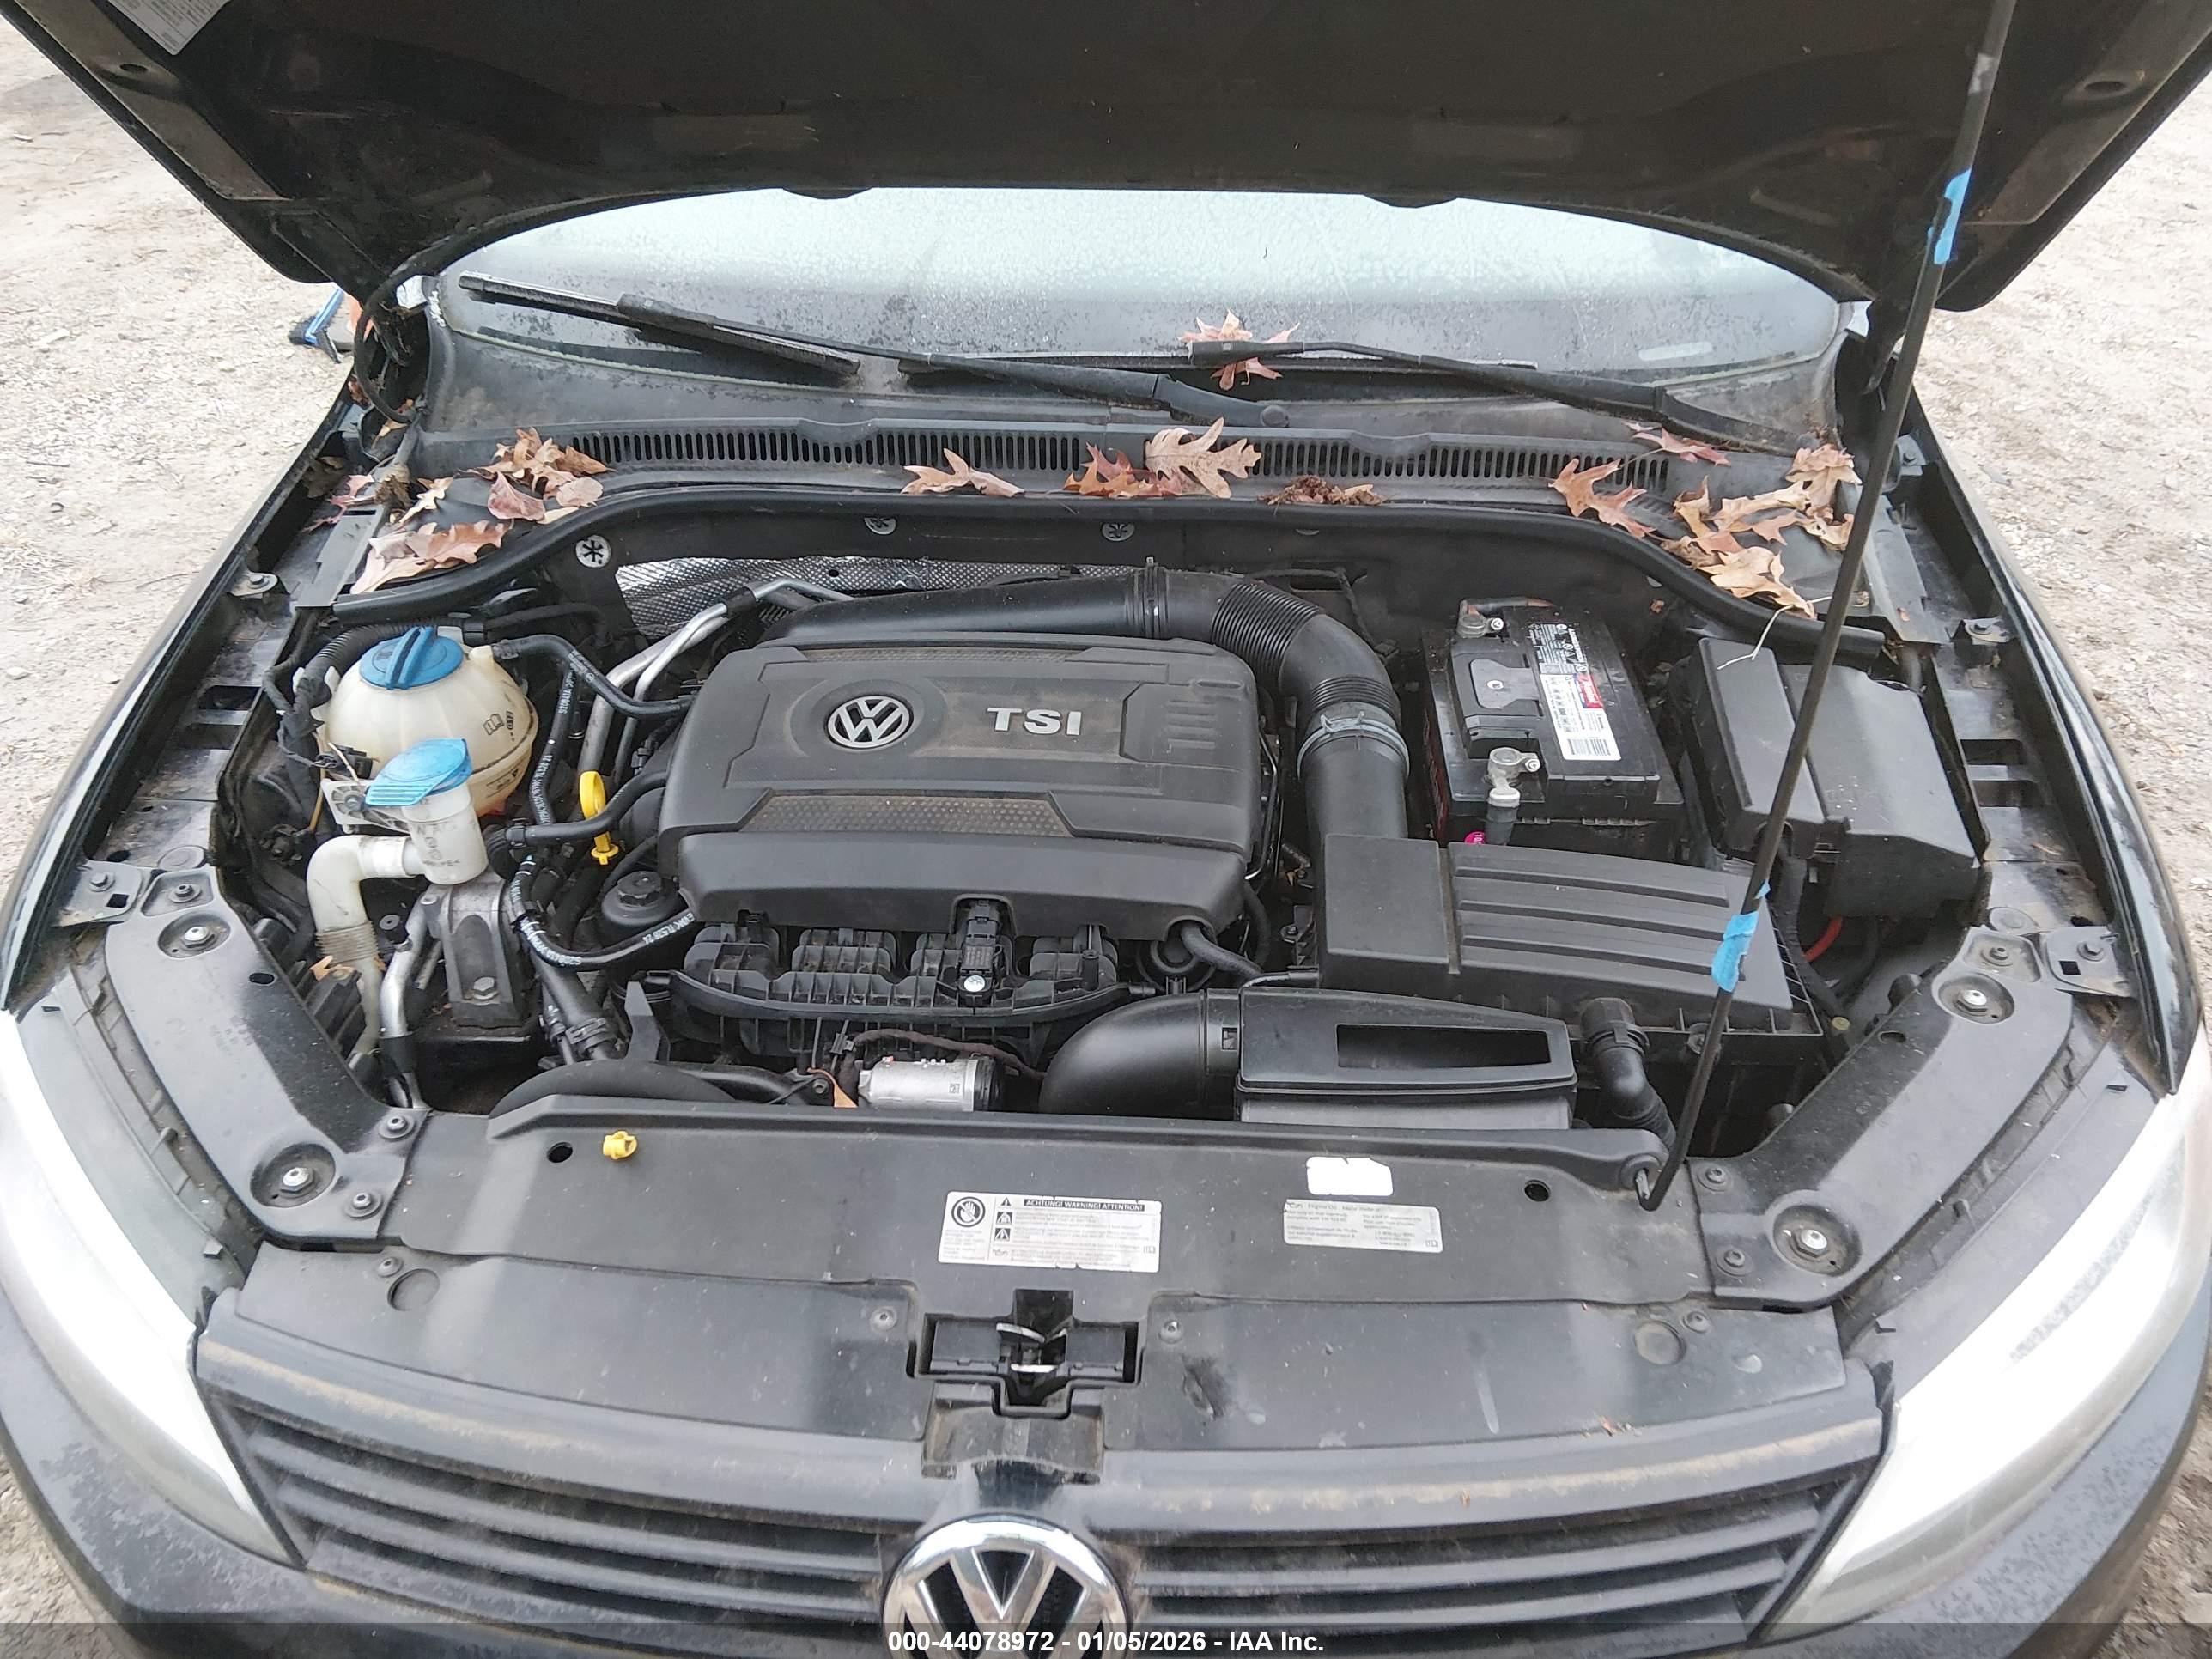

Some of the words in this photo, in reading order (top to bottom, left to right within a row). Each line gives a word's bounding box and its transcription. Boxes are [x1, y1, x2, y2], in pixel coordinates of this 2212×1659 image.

[987, 707, 1082, 736] TSI
[1025, 1199, 1063, 1207] ACHTUNG!
[1065, 1200, 1100, 1210] WARNING!
[1102, 1203, 1143, 1212] ATTENTION!
